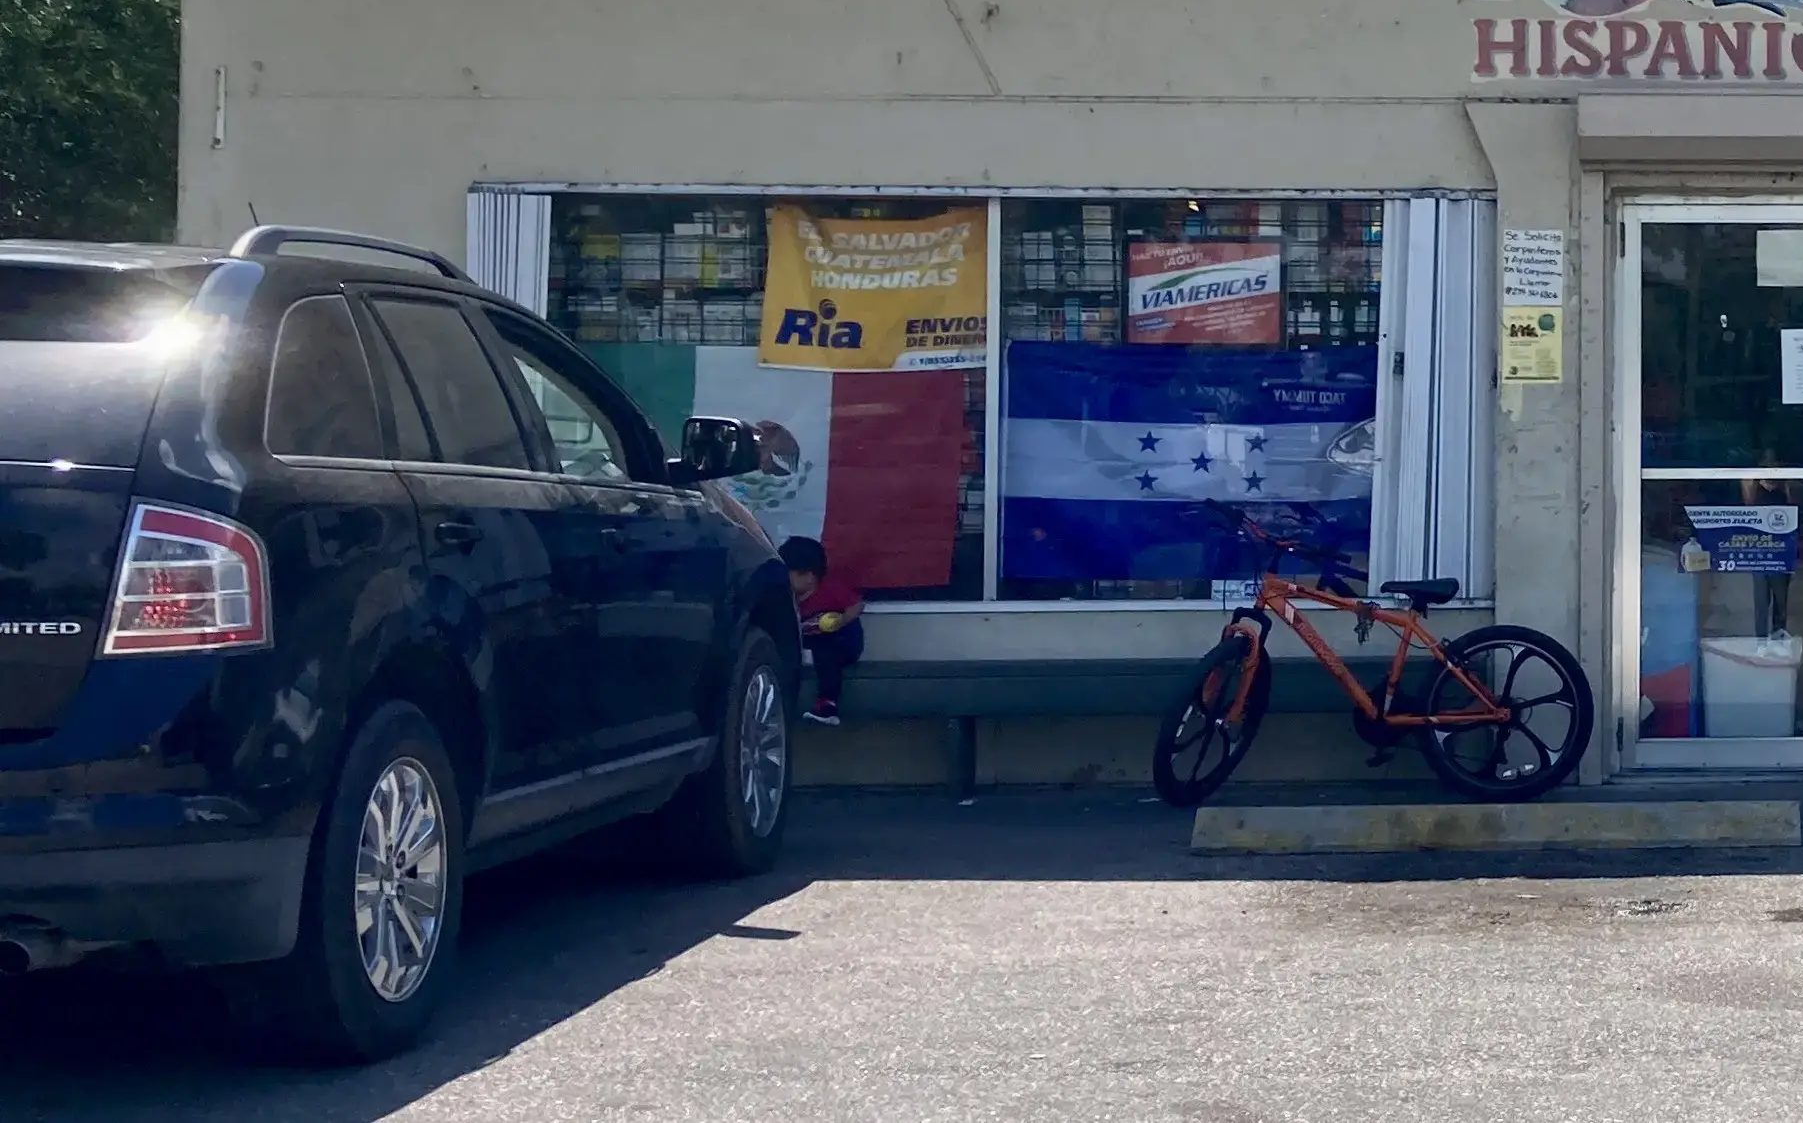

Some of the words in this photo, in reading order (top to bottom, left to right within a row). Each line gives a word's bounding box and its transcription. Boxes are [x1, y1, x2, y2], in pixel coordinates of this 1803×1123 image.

[831, 222, 972, 250] SALVADOR
[804, 244, 965, 270] GUATEMALA
[811, 267, 959, 290] HONDURAS
[1141, 274, 1269, 310] VIAMERICAS
[774, 298, 863, 349] Ria
[905, 335, 928, 348] DE
[932, 334, 987, 348] DINER
[1717, 560, 1736, 571] 30
